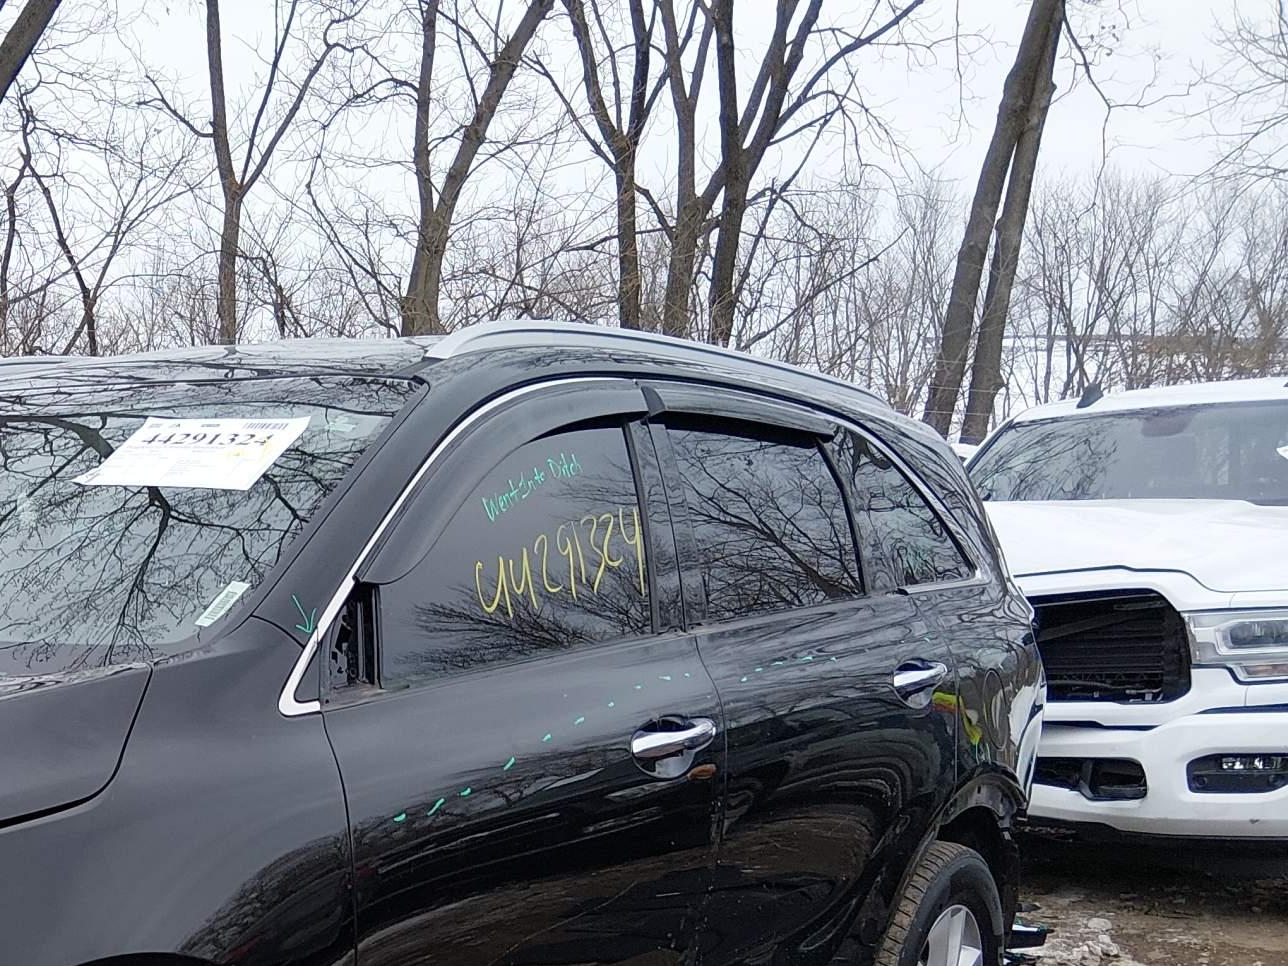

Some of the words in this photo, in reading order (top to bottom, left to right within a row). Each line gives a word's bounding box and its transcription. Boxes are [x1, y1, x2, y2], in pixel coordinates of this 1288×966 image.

[142, 432, 274, 446] 44291324
[482, 479, 519, 522] Went
[547, 453, 583, 479] Ditch
[475, 506, 646, 619] 44291324
